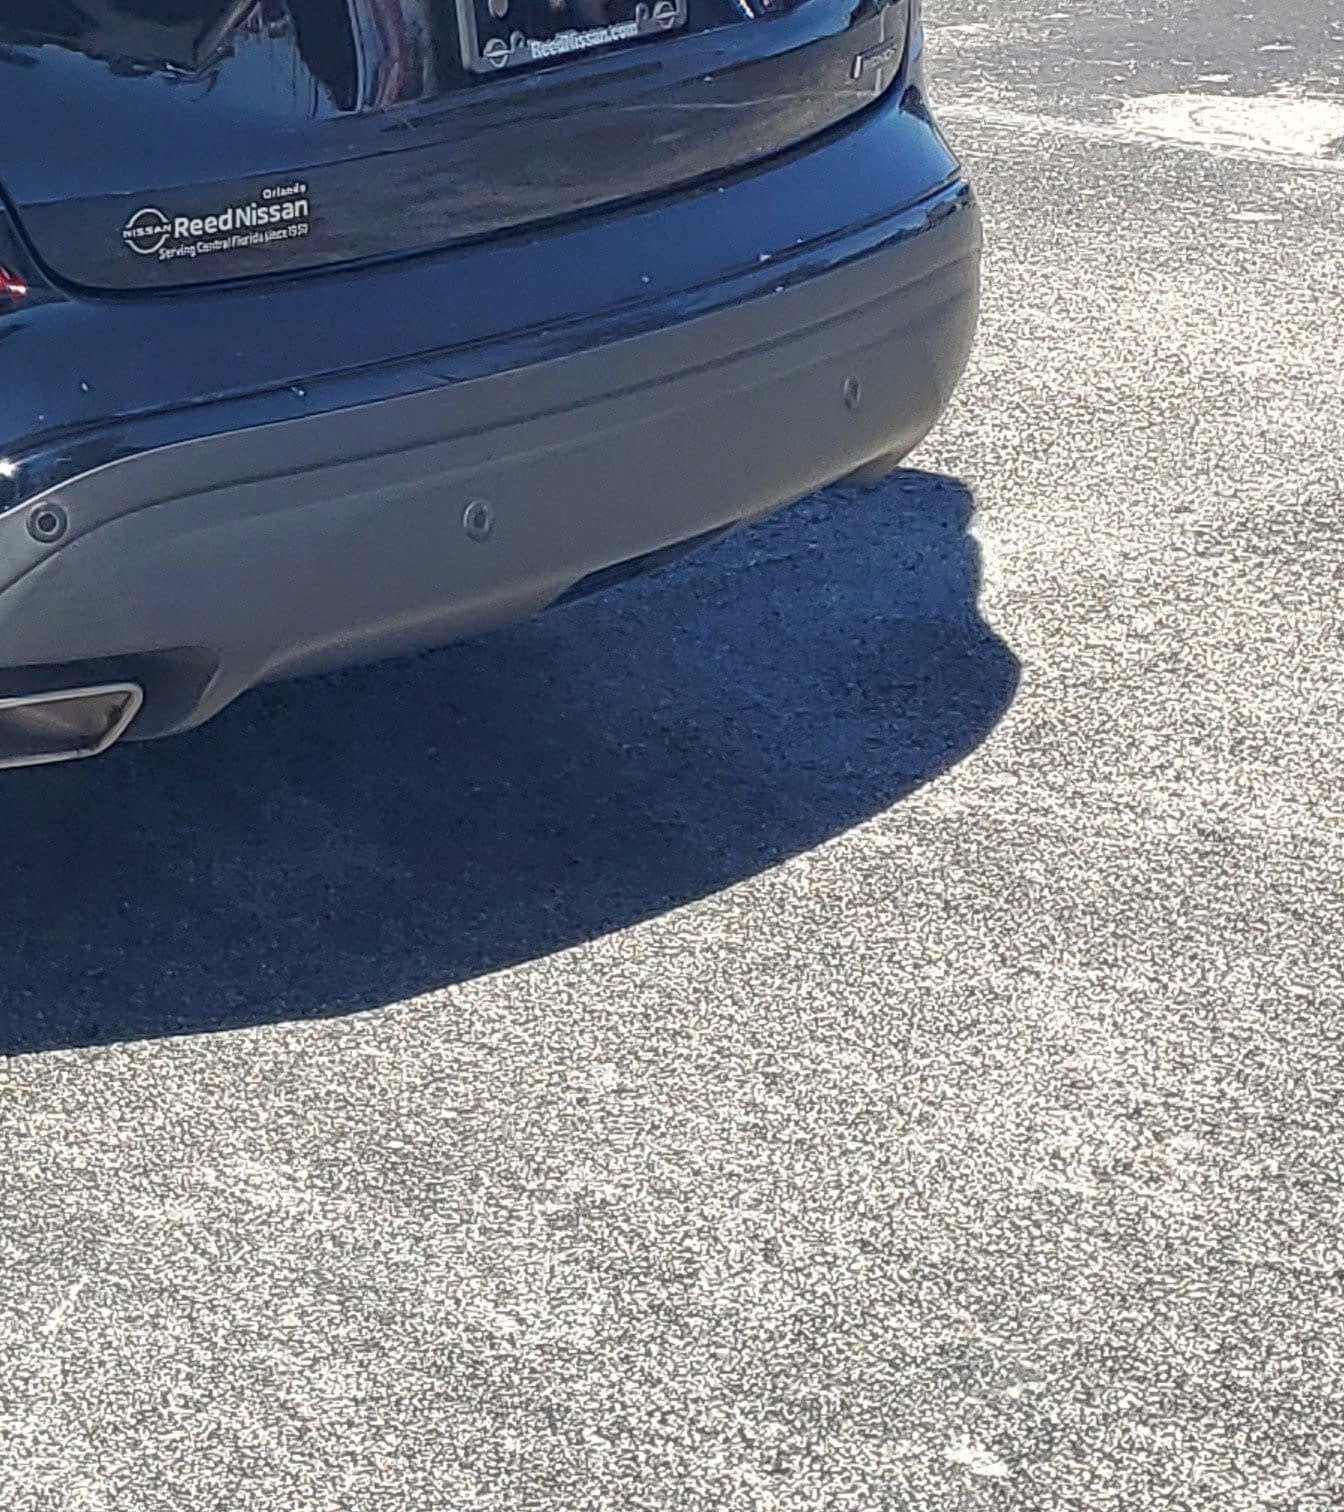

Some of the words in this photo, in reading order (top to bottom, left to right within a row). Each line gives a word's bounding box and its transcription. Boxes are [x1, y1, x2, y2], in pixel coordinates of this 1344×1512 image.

[530, 21, 639, 58] ReedNissan.com
[262, 183, 307, 200] Orlando
[122, 223, 172, 239] NISSAN
[158, 244, 197, 261] Serving
[196, 237, 233, 254] Central
[232, 232, 264, 249] Florida
